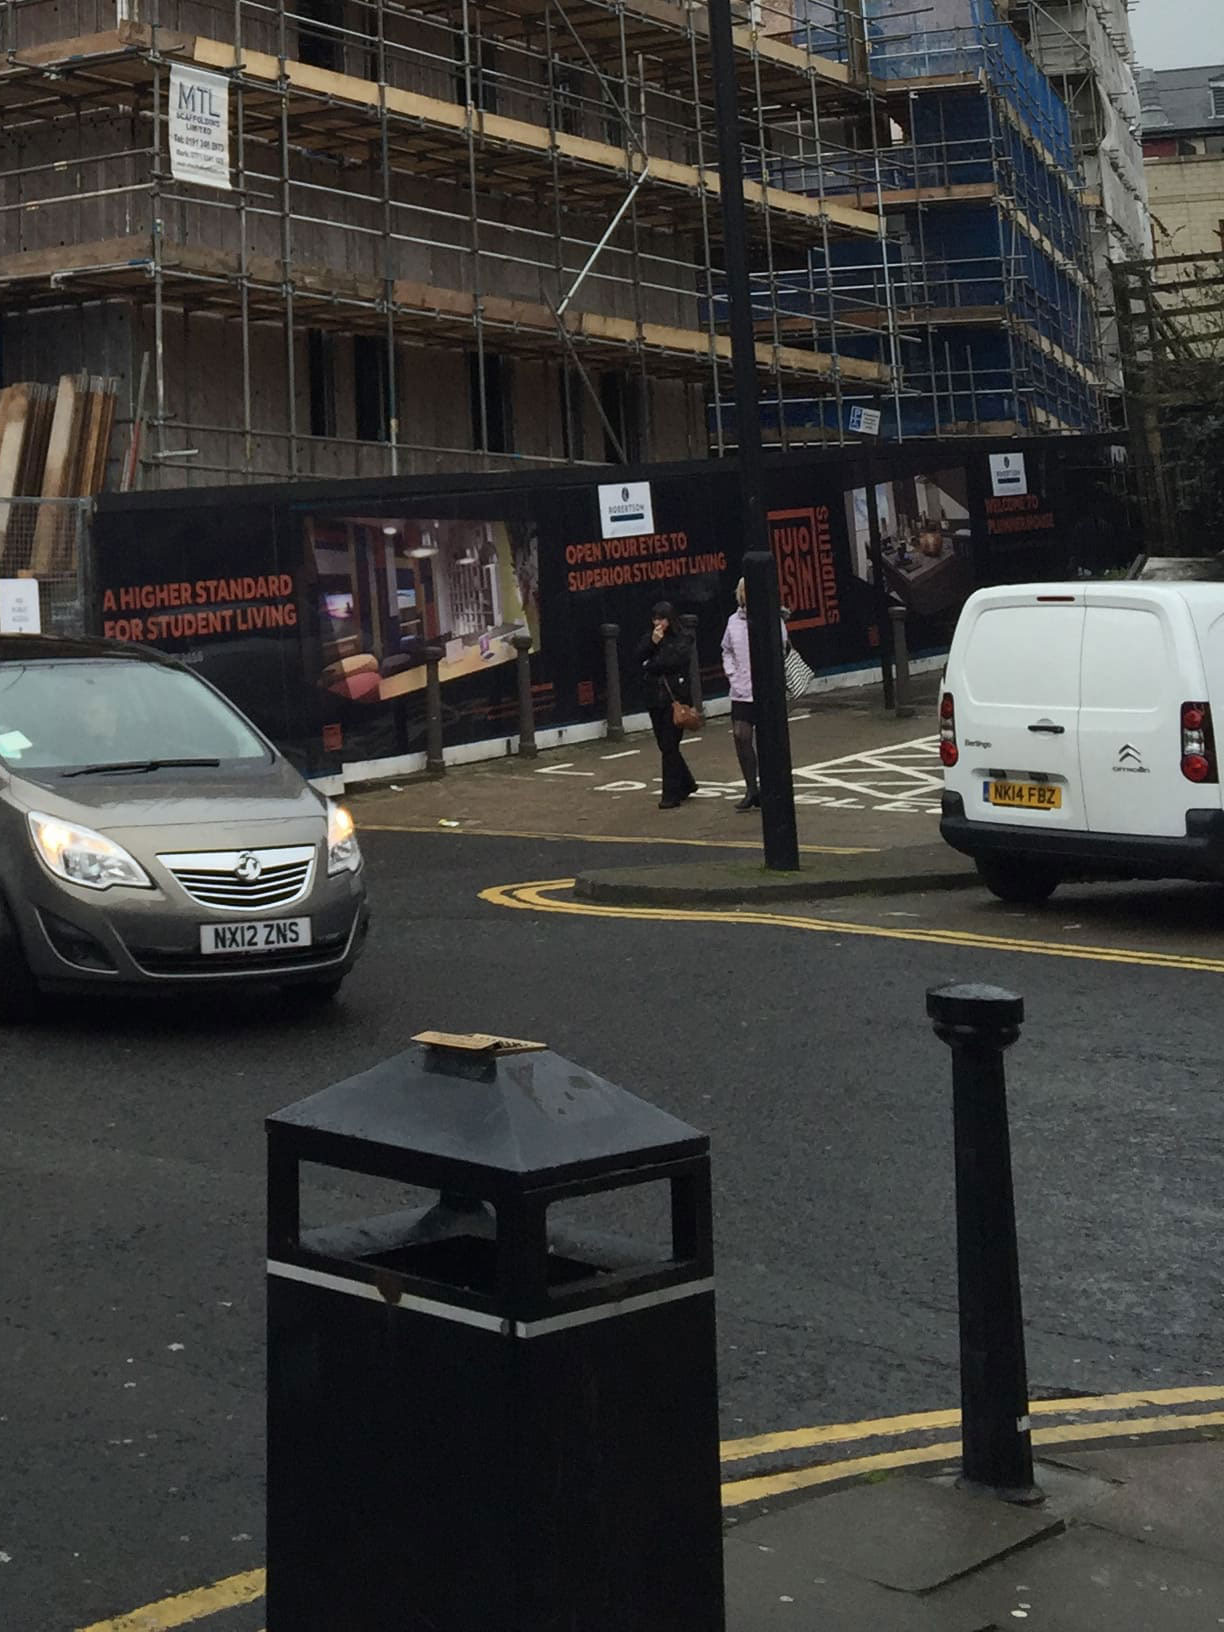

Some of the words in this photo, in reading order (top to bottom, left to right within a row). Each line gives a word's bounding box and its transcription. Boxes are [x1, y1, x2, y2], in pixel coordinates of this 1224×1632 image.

[177, 80, 221, 118] MTL
[566, 542, 602, 565] OPEN
[602, 538, 639, 559] YOUR
[640, 534, 669, 554] EYES
[670, 531, 687, 552] TO
[815, 505, 841, 625] STUDENTS
[568, 565, 633, 592] SUPERIOR
[633, 555, 687, 582] STUDENT
[688, 551, 728, 575] LIVING
[104, 588, 118, 611] A
[120, 581, 193, 611] HIGHER
[195, 574, 293, 604] STANDARD
[104, 618, 144, 641] FOR
[146, 609, 234, 640] STUDENT
[236, 603, 297, 631] LIVING
[964, 739, 992, 749] Berlingo
[994, 784, 1024, 802] NK14
[1028, 787, 1056, 805] FBZ
[214, 925, 258, 949] NX12
[264, 922, 300, 945] ZNS
